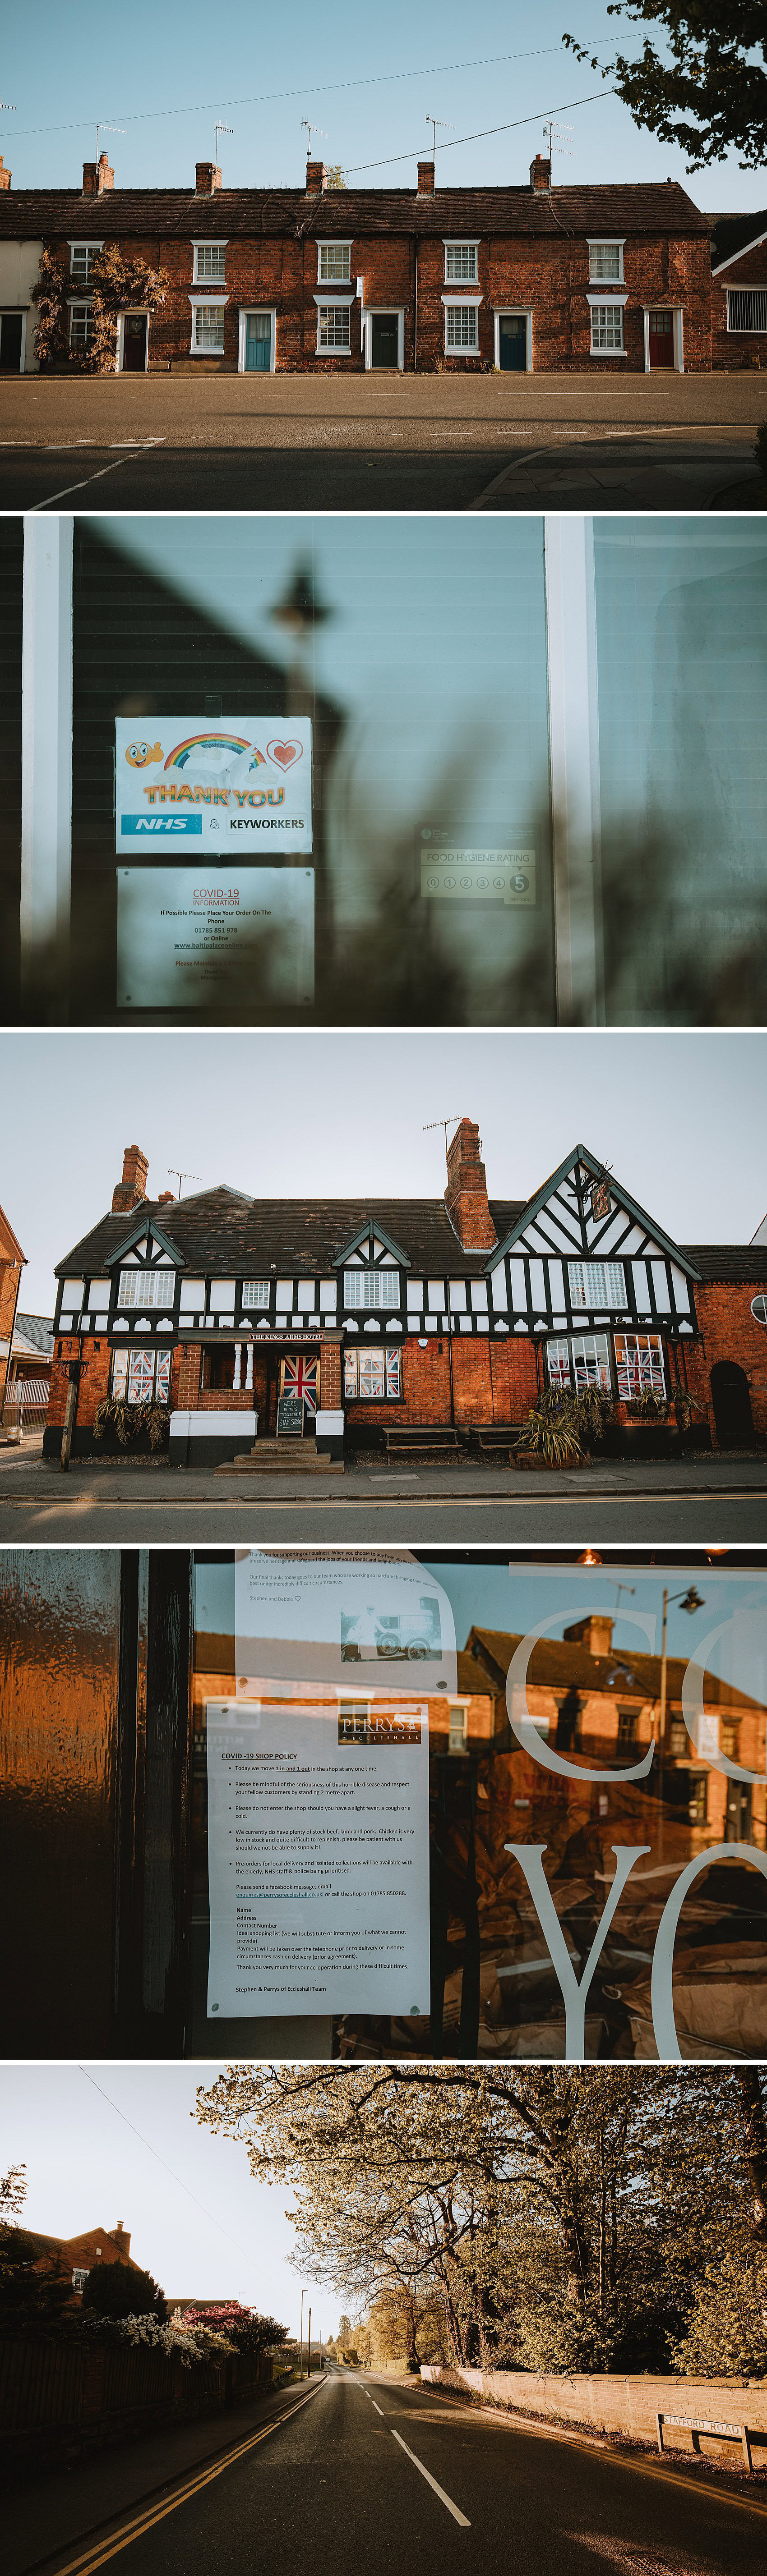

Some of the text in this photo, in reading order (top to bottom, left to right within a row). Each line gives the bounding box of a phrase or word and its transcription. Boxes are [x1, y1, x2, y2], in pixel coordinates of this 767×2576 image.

[143, 784, 285, 808] THANK YOU
[135, 818, 305, 829] NHS & KEYWORKERS
[457, 854, 495, 862] HYGIENE
[515, 877, 524, 891] 5
[193, 889, 239, 898] COVID-19
[342, 1718, 405, 1732] PERRYS
[664, 2416, 739, 2434] STAFFORD ROAD
